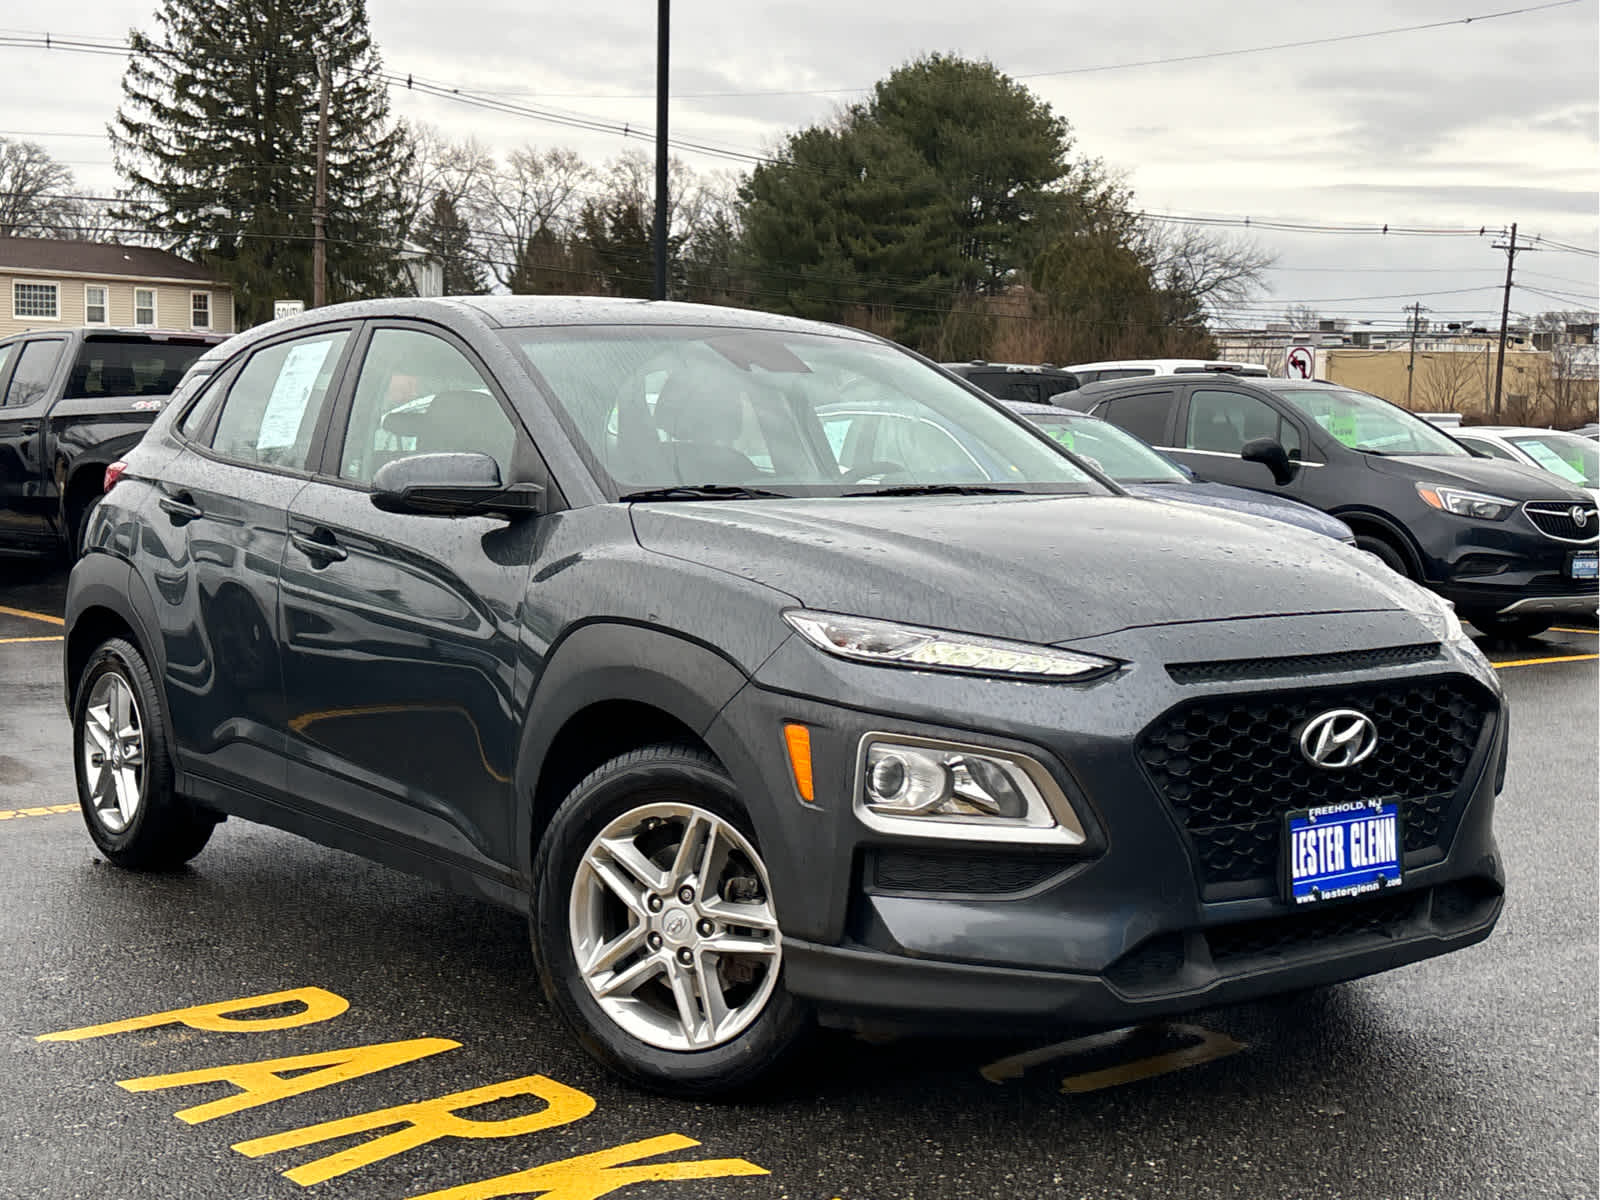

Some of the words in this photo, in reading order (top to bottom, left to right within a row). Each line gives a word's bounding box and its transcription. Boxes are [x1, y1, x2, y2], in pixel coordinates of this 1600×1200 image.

[276, 306, 301, 320] SOUT
[1308, 801, 1366, 817] FREEHOLD,
[1368, 798, 1383, 809] NJ
[1291, 825, 1345, 879] LESTER
[1351, 817, 1397, 868] GLENN
